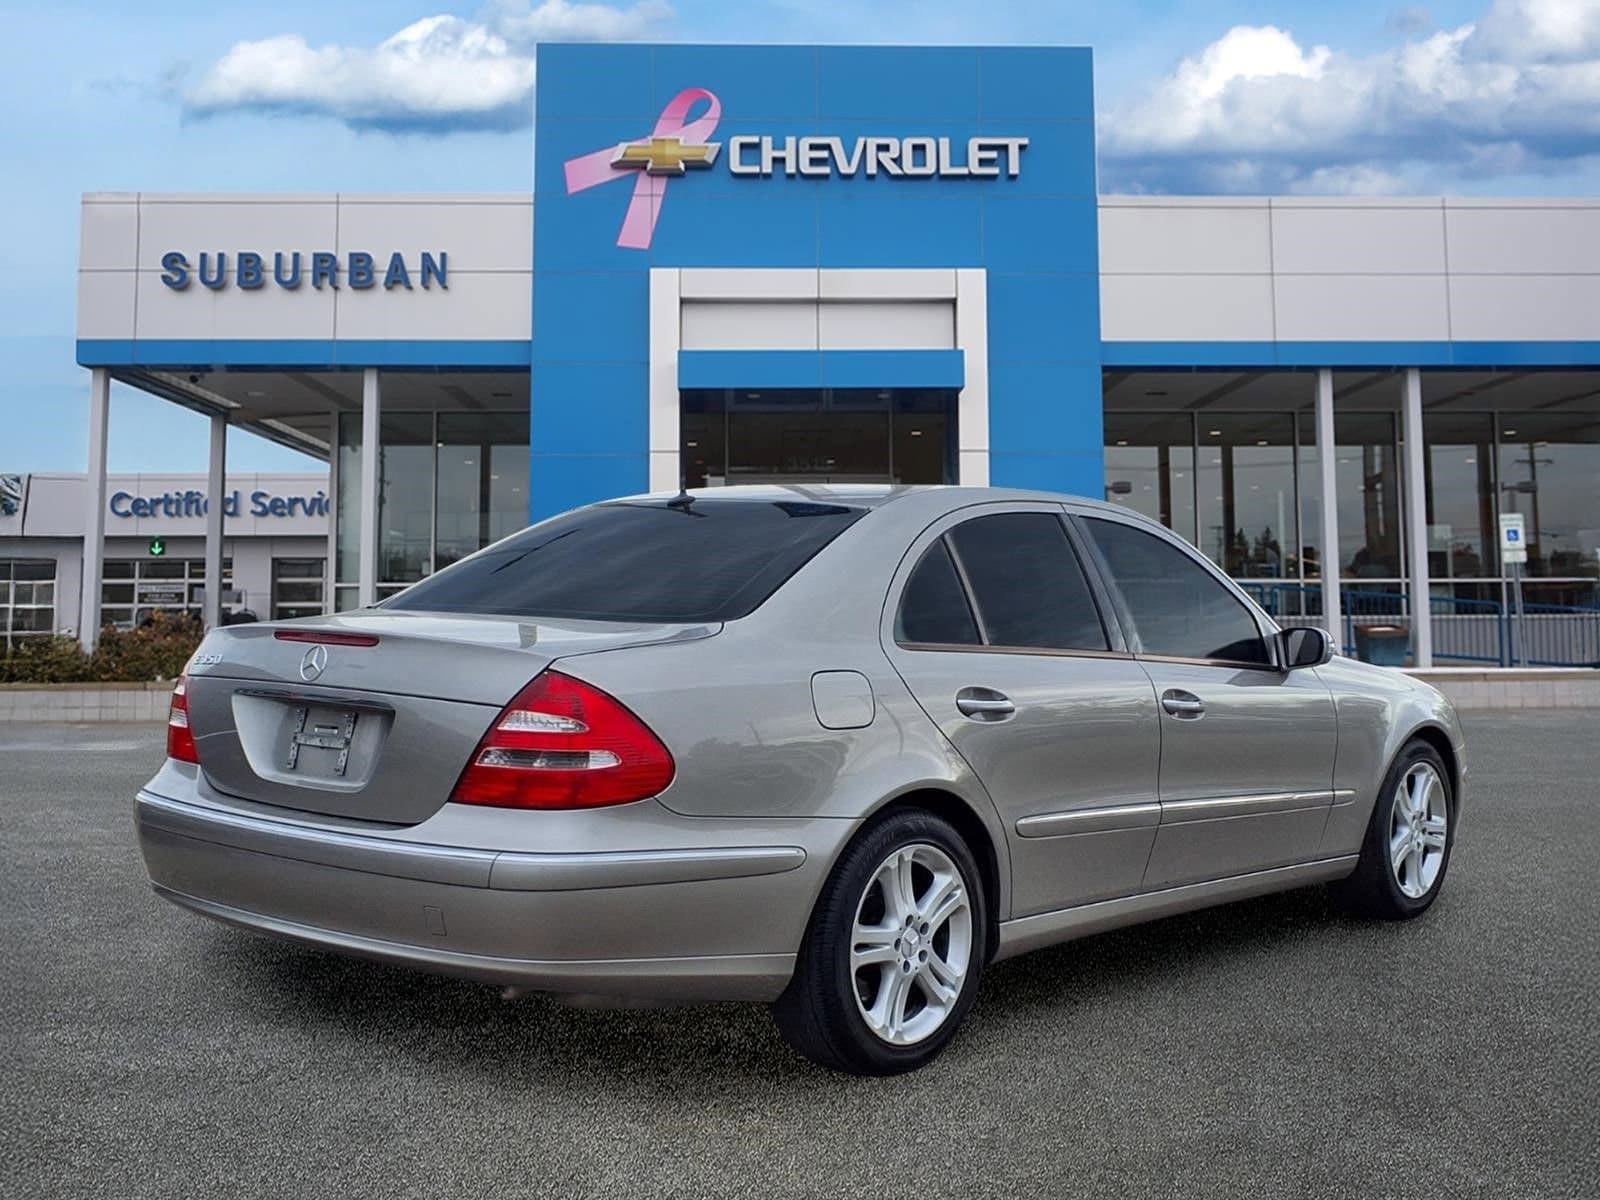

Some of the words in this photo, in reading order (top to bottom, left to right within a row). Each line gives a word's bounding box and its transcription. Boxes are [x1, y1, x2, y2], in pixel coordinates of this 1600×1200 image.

[729, 135, 1030, 176] CHEVROLET
[161, 251, 449, 289] SUBURBAN
[110, 490, 241, 517] Certifid
